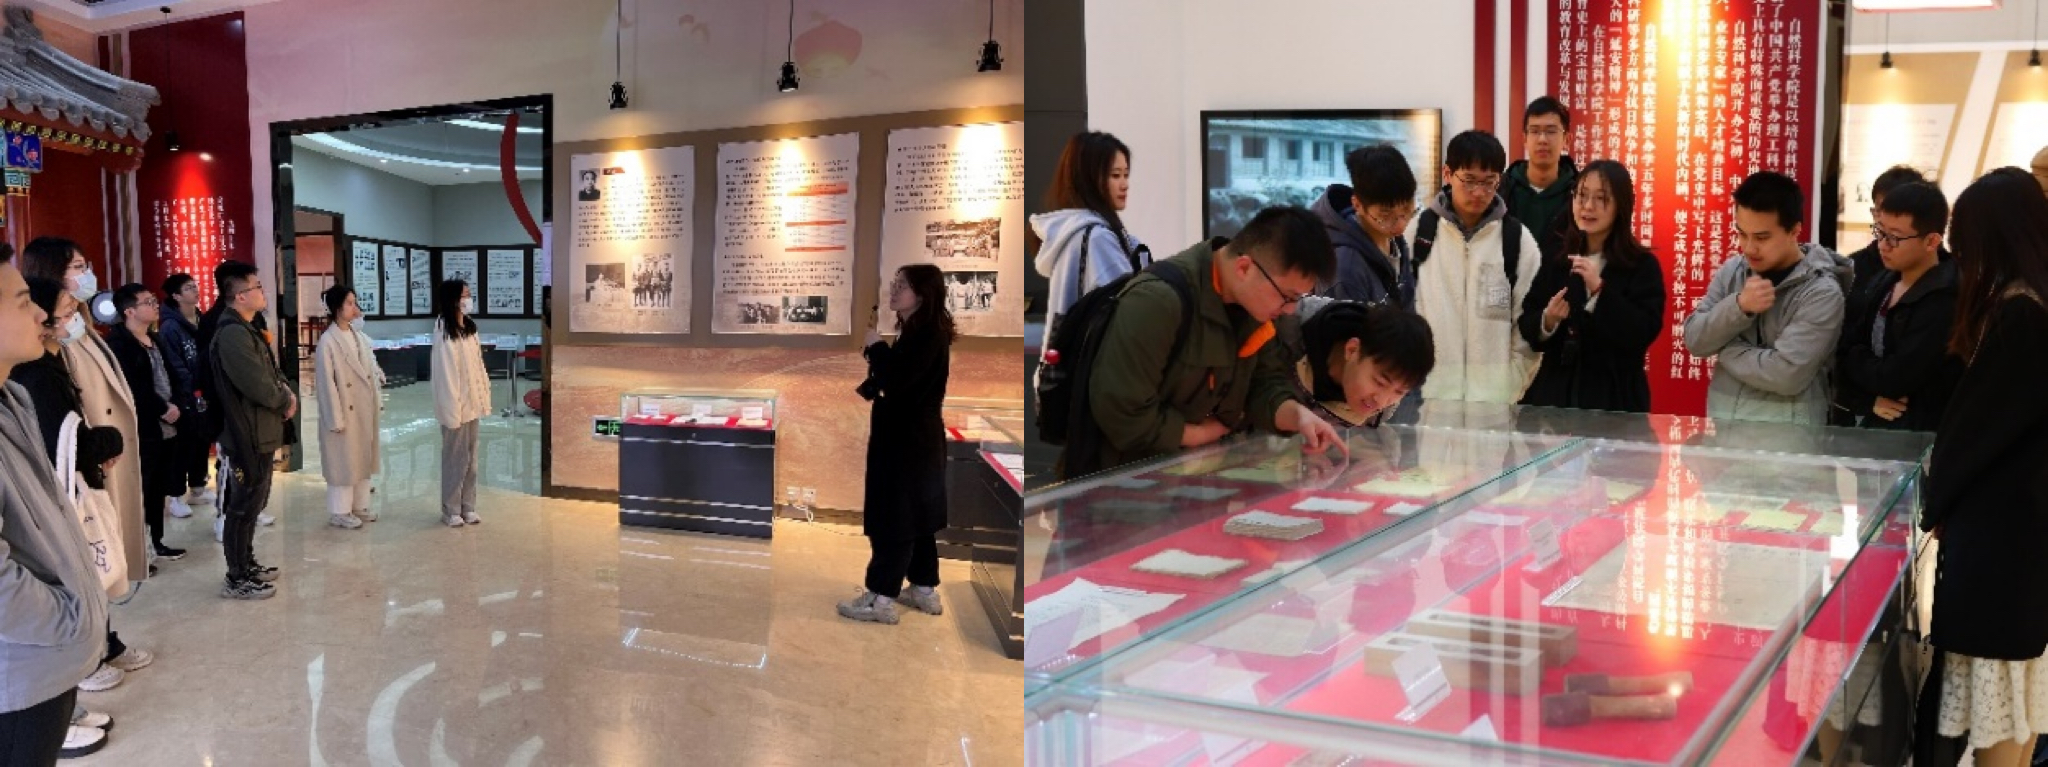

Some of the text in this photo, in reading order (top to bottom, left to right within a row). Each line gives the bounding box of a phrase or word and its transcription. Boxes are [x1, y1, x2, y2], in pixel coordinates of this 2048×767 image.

[1747, 0, 1766, 176] 上具有特殊而重要的历史地
[1766, 0, 1784, 171] 了中国共产党举办理工科
